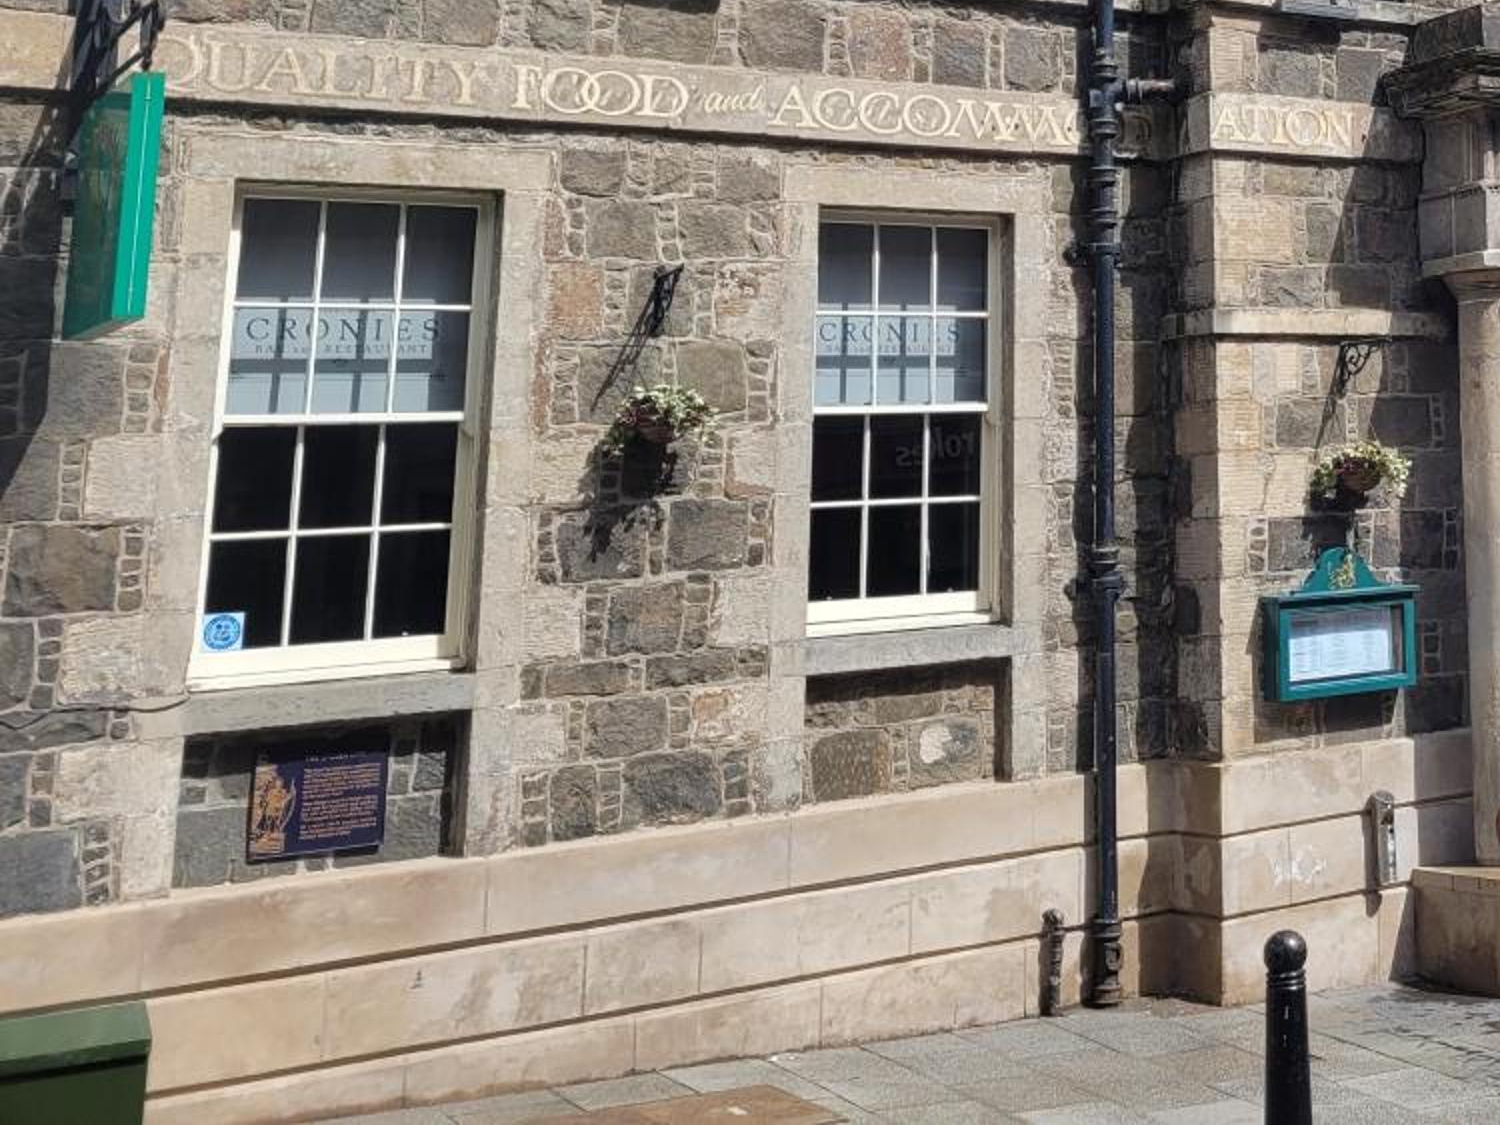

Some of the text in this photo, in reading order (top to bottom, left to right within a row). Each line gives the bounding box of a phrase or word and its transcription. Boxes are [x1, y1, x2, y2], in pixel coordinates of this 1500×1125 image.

[153, 33, 482, 105] QUALITY
[511, 64, 689, 118] FOOD
[703, 84, 765, 114] and
[246, 317, 440, 342] CRONIES
[819, 322, 960, 344] CRONIS
